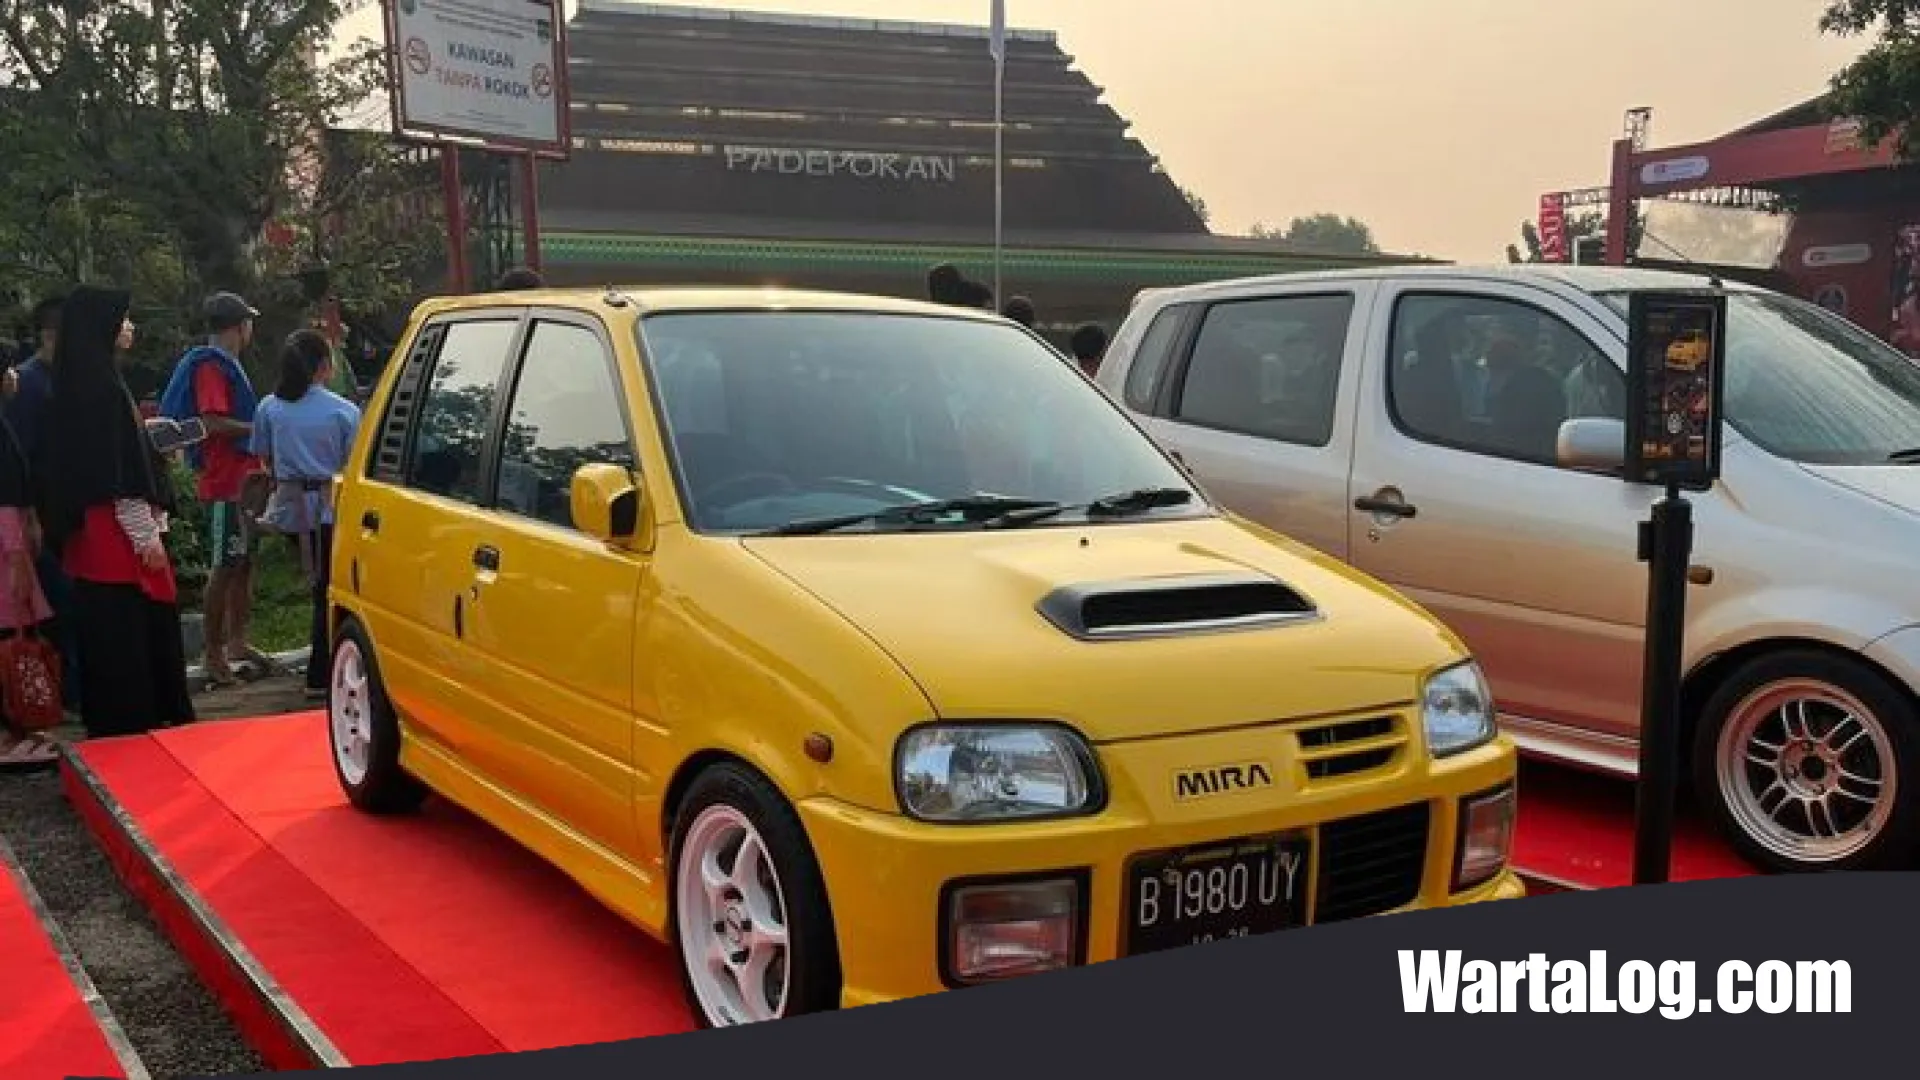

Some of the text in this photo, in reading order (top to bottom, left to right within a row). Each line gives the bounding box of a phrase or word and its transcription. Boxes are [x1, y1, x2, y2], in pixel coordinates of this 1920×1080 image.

[447, 42, 515, 70] KAWASAN
[484, 75, 531, 100] ROKOK
[724, 145, 955, 182] PADEPOKAN
[1176, 764, 1271, 796] MIRA
[1140, 852, 1300, 927] B 1980 UY
